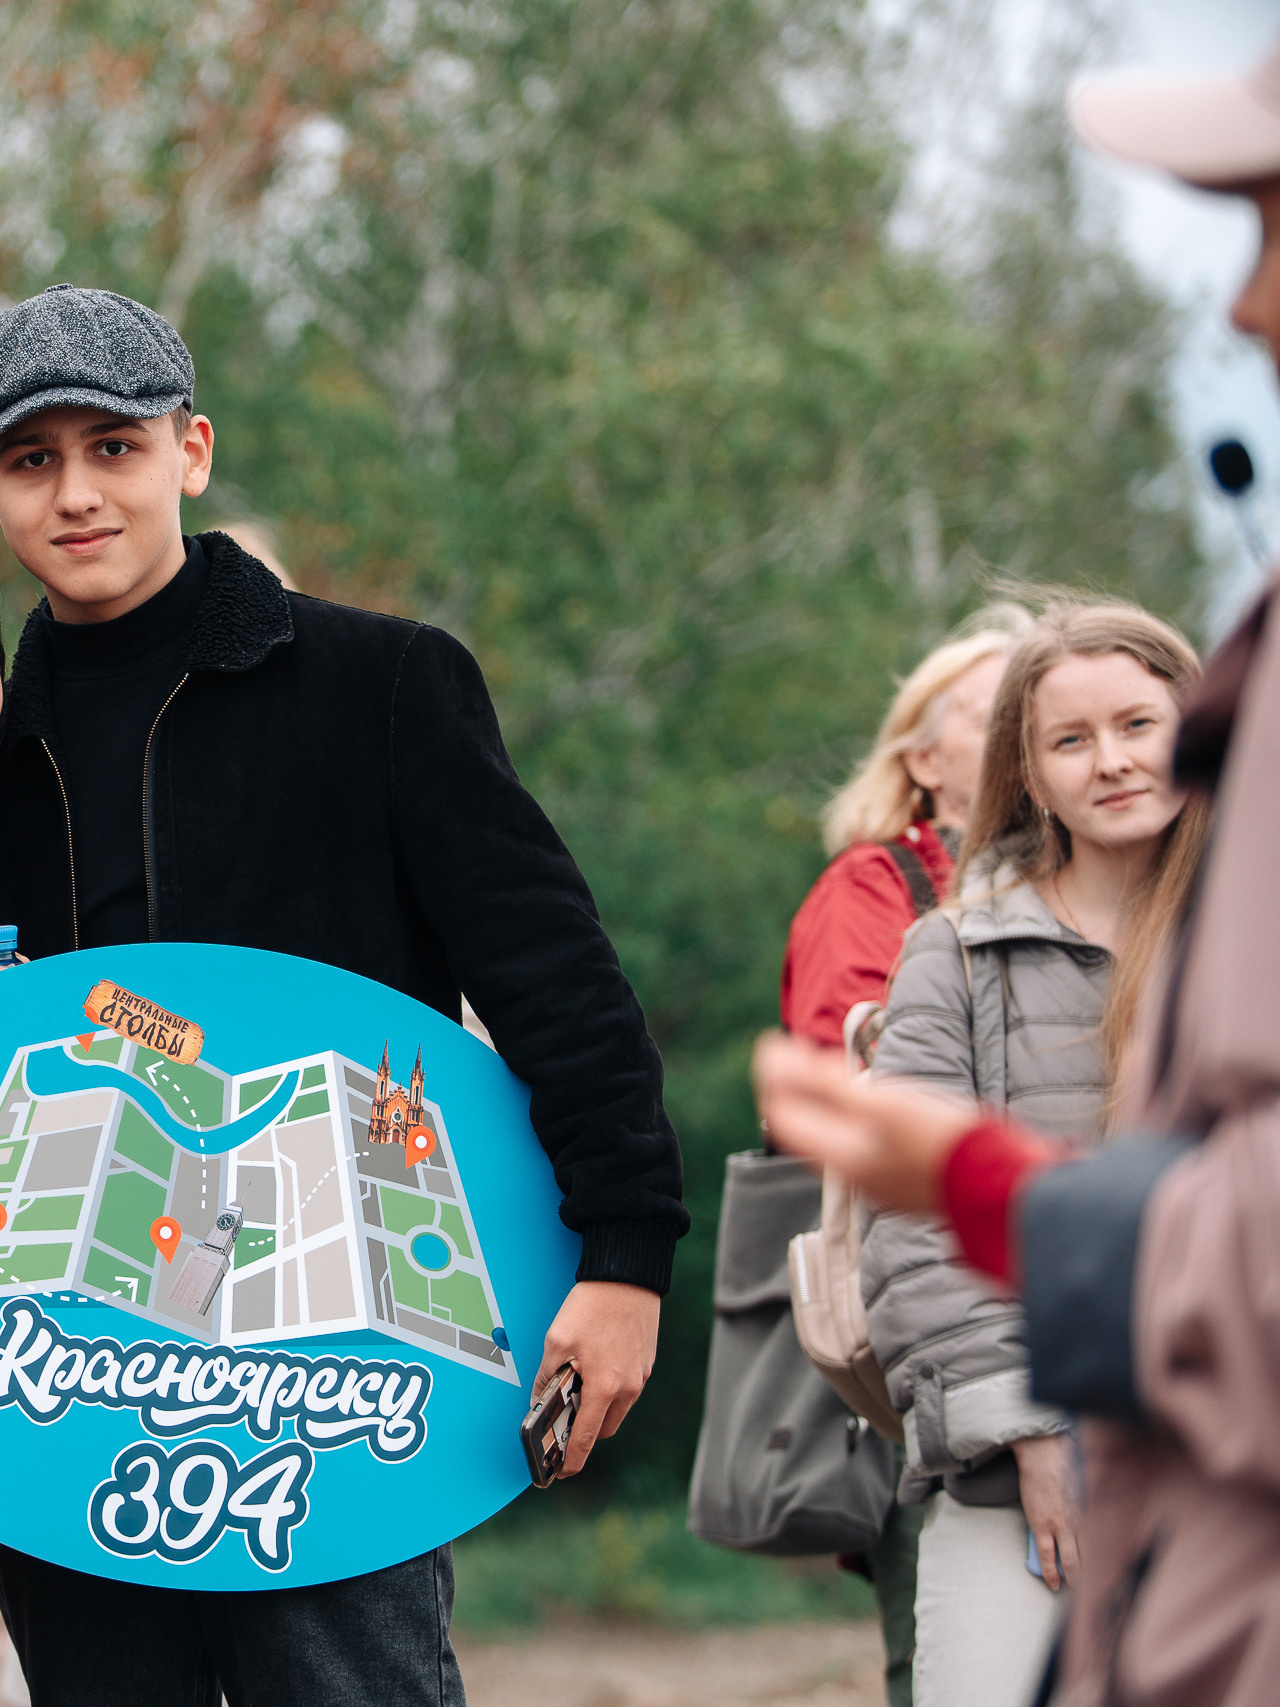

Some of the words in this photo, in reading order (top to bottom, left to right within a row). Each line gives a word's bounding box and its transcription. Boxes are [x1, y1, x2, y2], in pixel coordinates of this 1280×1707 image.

[99, 1001, 185, 1057] СТОЛБЫ
[112, 988, 189, 1033] ЦЕНТРАЛЬНЫЕ
[101, 1453, 305, 1560] 394
